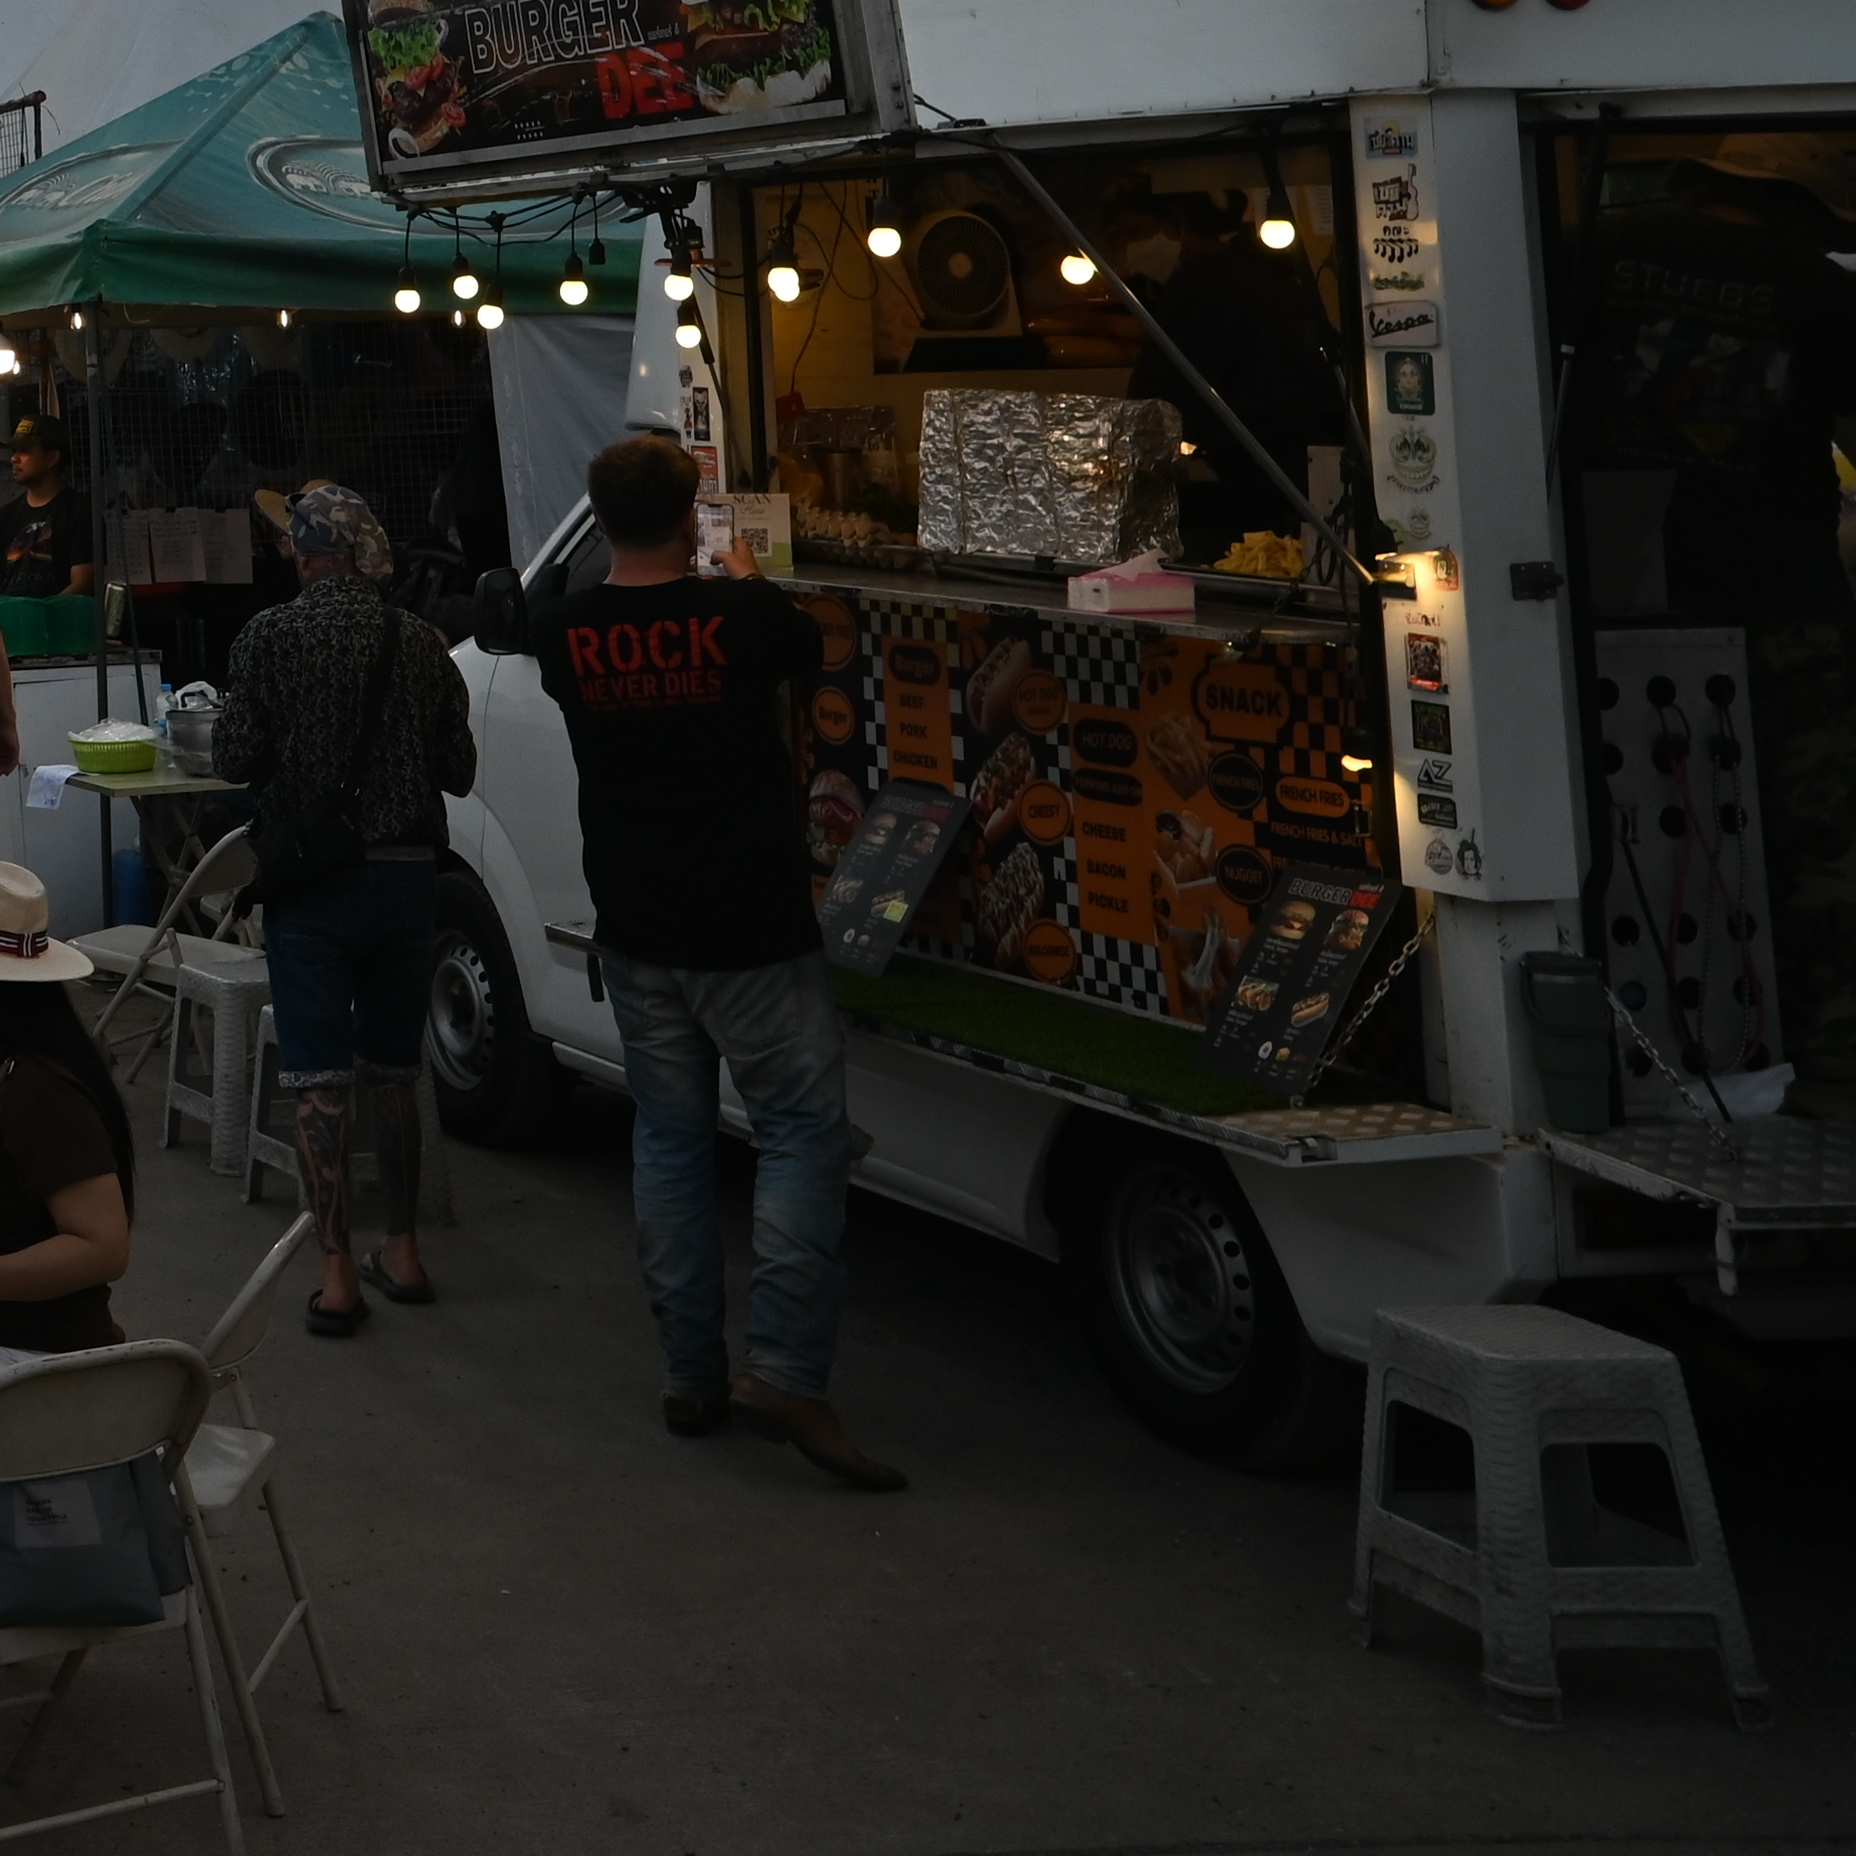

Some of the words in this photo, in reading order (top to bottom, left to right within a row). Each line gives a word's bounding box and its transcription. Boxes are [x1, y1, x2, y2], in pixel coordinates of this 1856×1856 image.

[595, 41, 694, 120] DEE
[1369, 310, 1435, 338] Vespa
[566, 615, 728, 678] ROCK
[895, 655, 935, 679] Burger
[579, 673, 658, 703] NEVER
[664, 669, 723, 696] DIES
[899, 694, 925, 710] BEEF
[1206, 684, 1283, 717] SNACK
[818, 706, 847, 726] Burger
[900, 722, 928, 740] PORK
[1083, 732, 1106, 748] HOT
[1109, 734, 1132, 750] DOG
[893, 750, 938, 770] CHICKEN
[1279, 784, 1318, 803] FRENCH
[1320, 790, 1345, 807] FRIES
[1028, 804, 1060, 819] CHEESY
[1082, 821, 1127, 842] CHEESE
[1270, 821, 1305, 838] FRENCH
[1307, 826, 1329, 843] FRIES
[1086, 859, 1127, 880] BACON
[1225, 866, 1263, 885] NUGGET
[1088, 891, 1129, 913] PICKLE
[1288, 877, 1353, 905] BURGER
[1349, 890, 1382, 910] DEE
